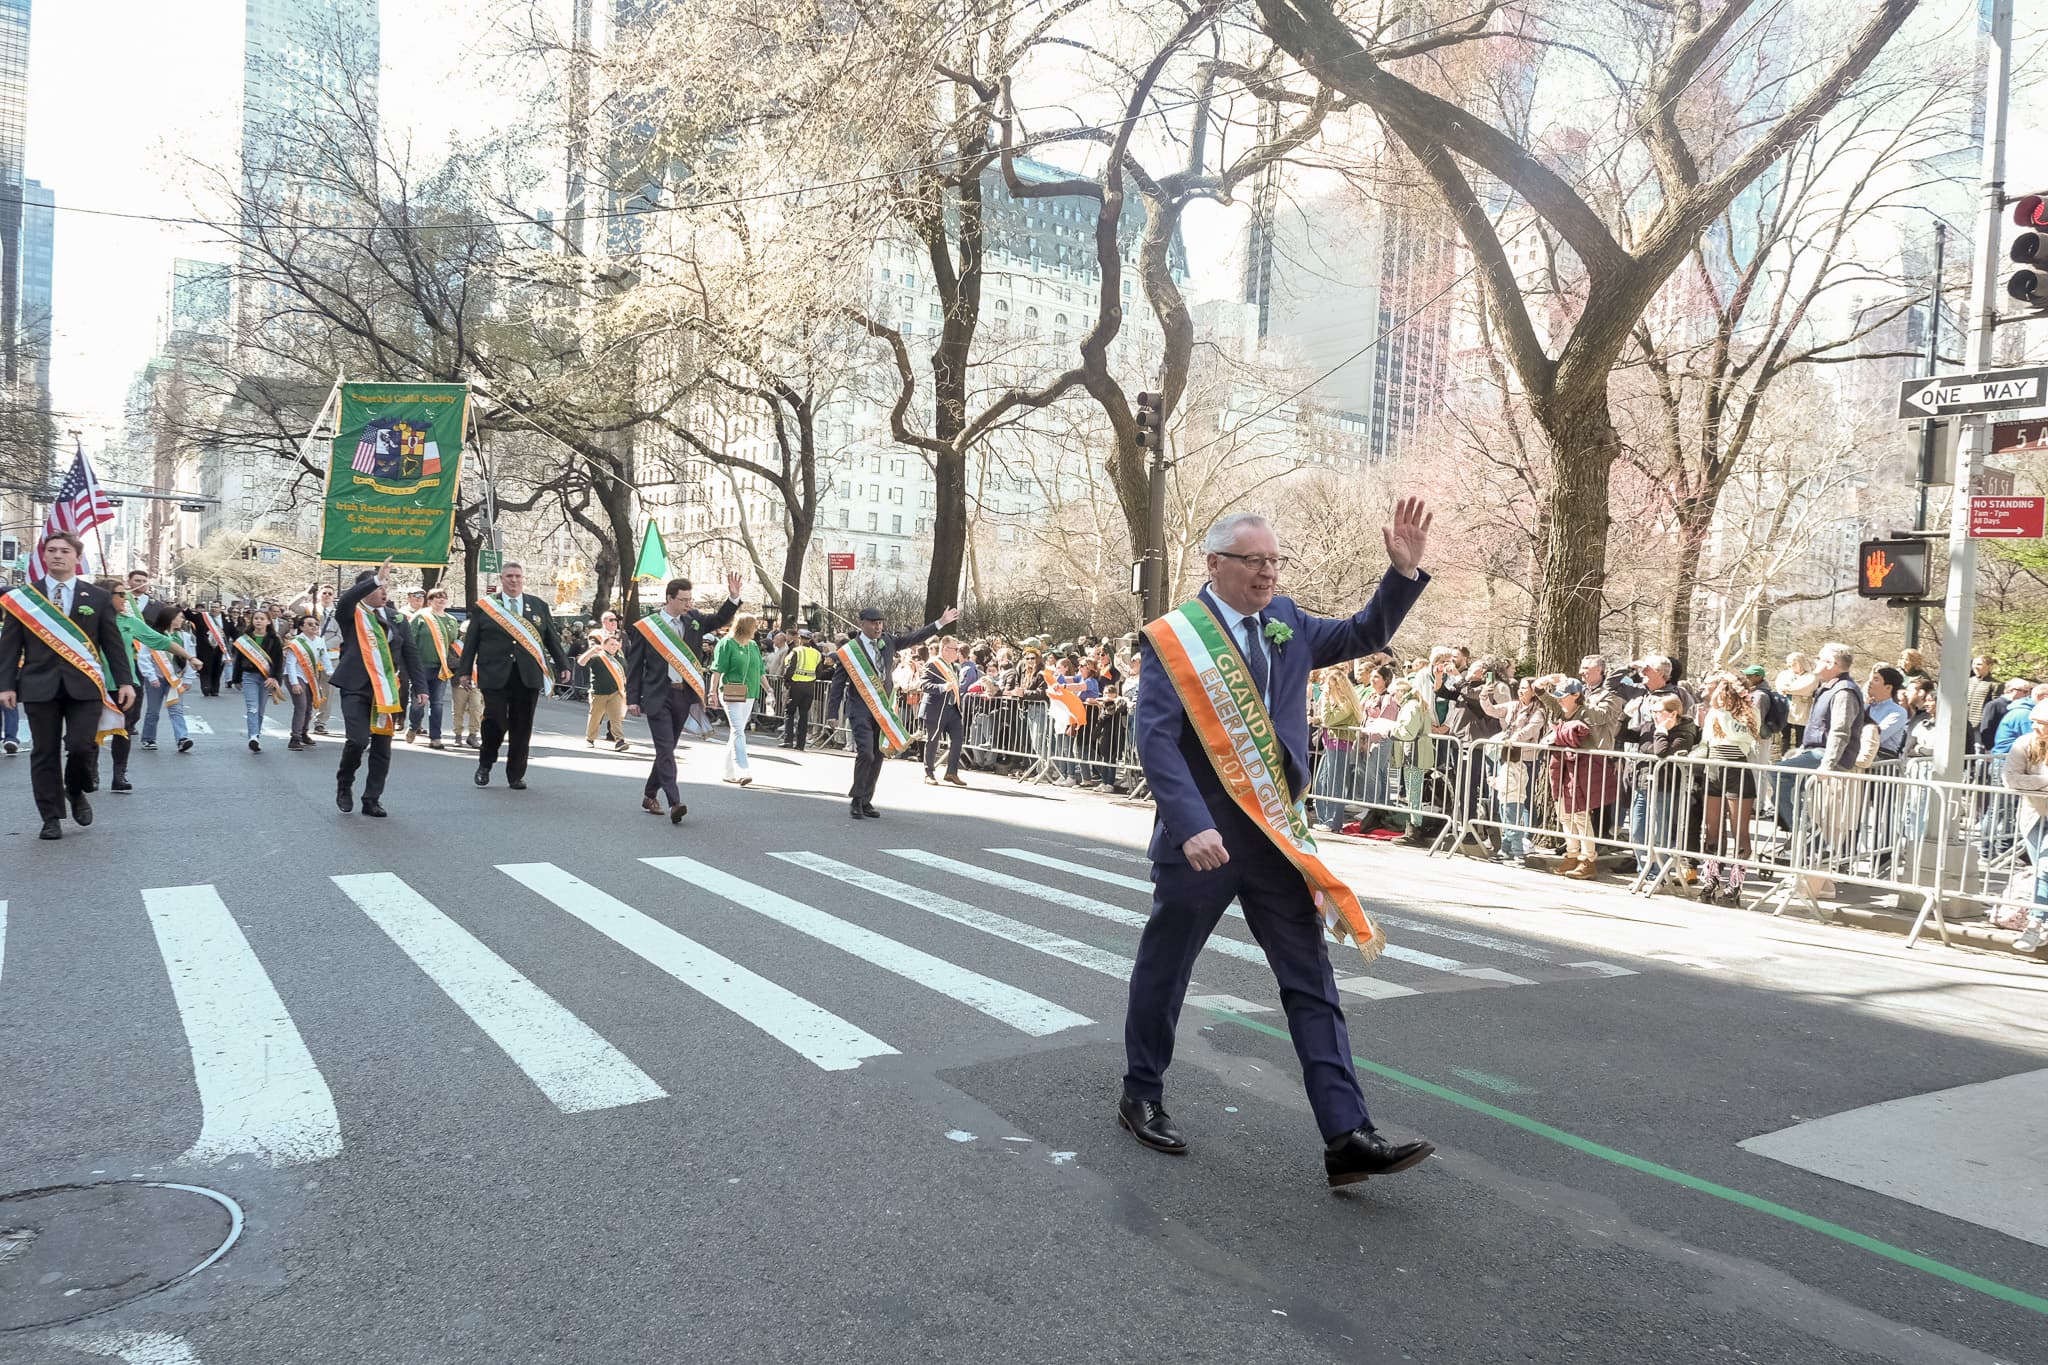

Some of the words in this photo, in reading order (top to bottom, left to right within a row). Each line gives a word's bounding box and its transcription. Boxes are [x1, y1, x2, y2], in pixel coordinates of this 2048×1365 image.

[422, 394, 456, 405] Society
[1921, 387, 1961, 405] ONE
[1983, 381, 2028, 400] WAY
[2016, 429, 2027, 448] 5
[1988, 476, 1998, 496] 61
[2001, 479, 2009, 496] St
[336, 502, 358, 512] Irish
[360, 503, 401, 515] Resident
[1973, 500, 1987, 509] NO
[1989, 500, 2035, 509] STANDING
[1994, 510, 2010, 518] 7pm
[1984, 517, 2001, 525] Days
[351, 526, 361, 534] of
[362, 526, 384, 535] New
[386, 526, 407, 535] York
[409, 527, 427, 537] City
[39, 628, 89, 672] EMERALD
[1216, 653, 1268, 738] GRAND
[1199, 667, 1265, 779] EMERALD
[1216, 747, 1254, 798] 2024
